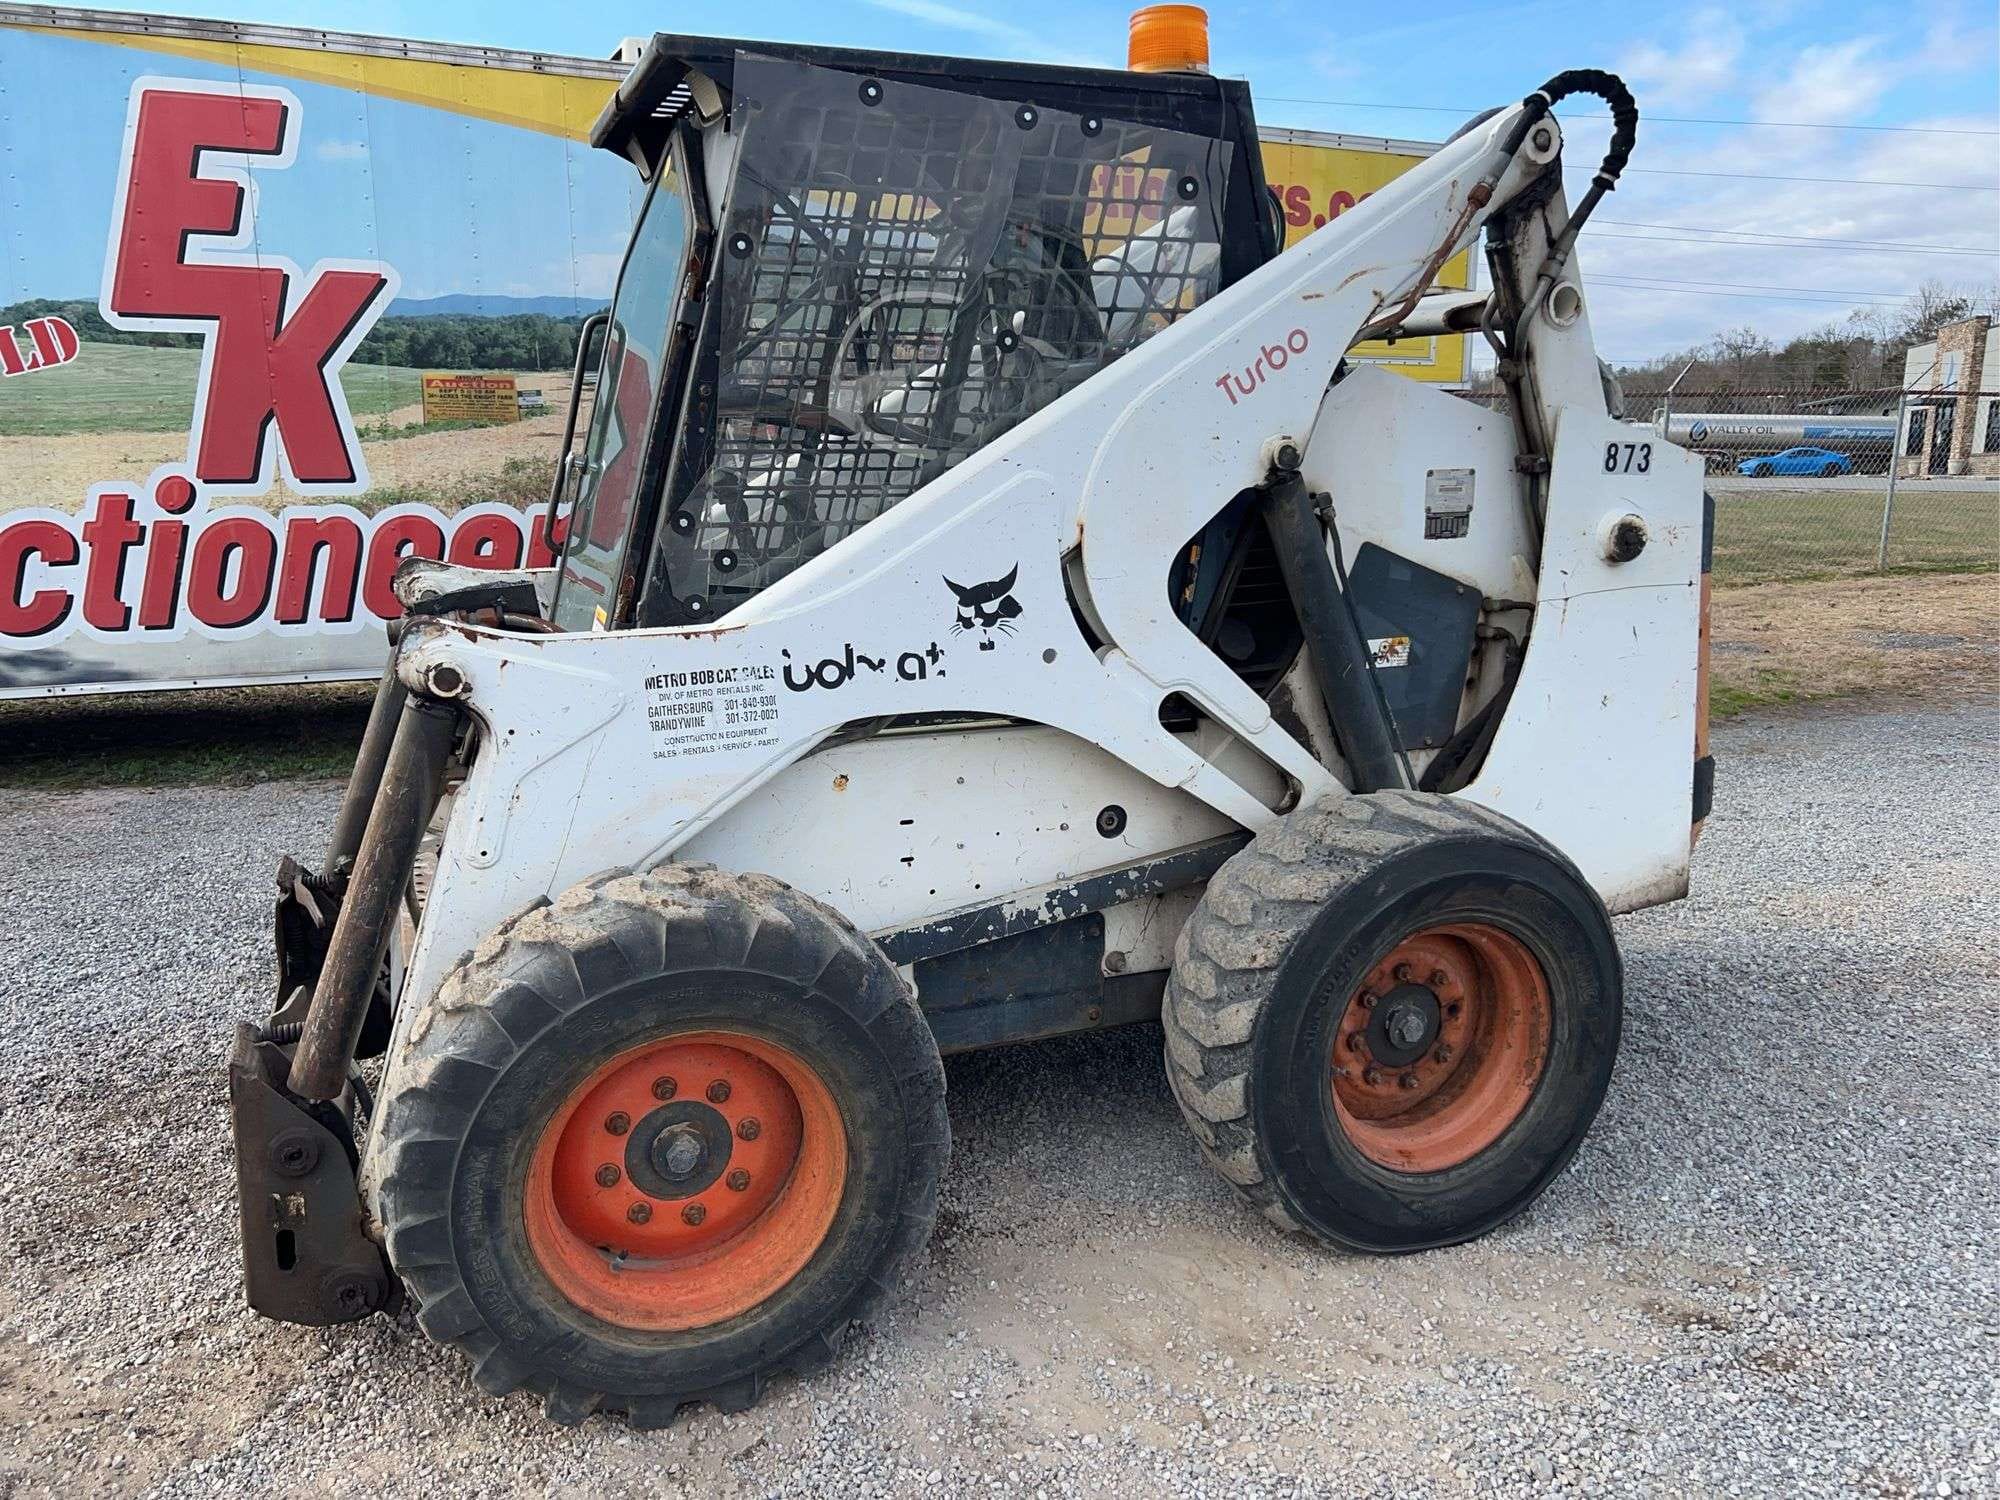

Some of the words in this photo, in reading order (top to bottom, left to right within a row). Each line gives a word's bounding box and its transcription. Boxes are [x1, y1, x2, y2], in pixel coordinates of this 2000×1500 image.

[1216, 328, 1309, 405] Turbo
[429, 379, 511, 389] Auction
[1708, 425, 1752, 435] VALLEY
[1756, 425, 1776, 435] OIL
[1605, 443, 1652, 473] 873
[645, 673, 687, 690] METRO
[675, 691, 685, 700] OF
[687, 688, 713, 698] METRO
[717, 685, 750, 695] RENTALS
[648, 701, 713, 718] GAITHERSBURG
[725, 709, 778, 724] 301-372-0021
[726, 727, 768, 739] EQUIPMENT
